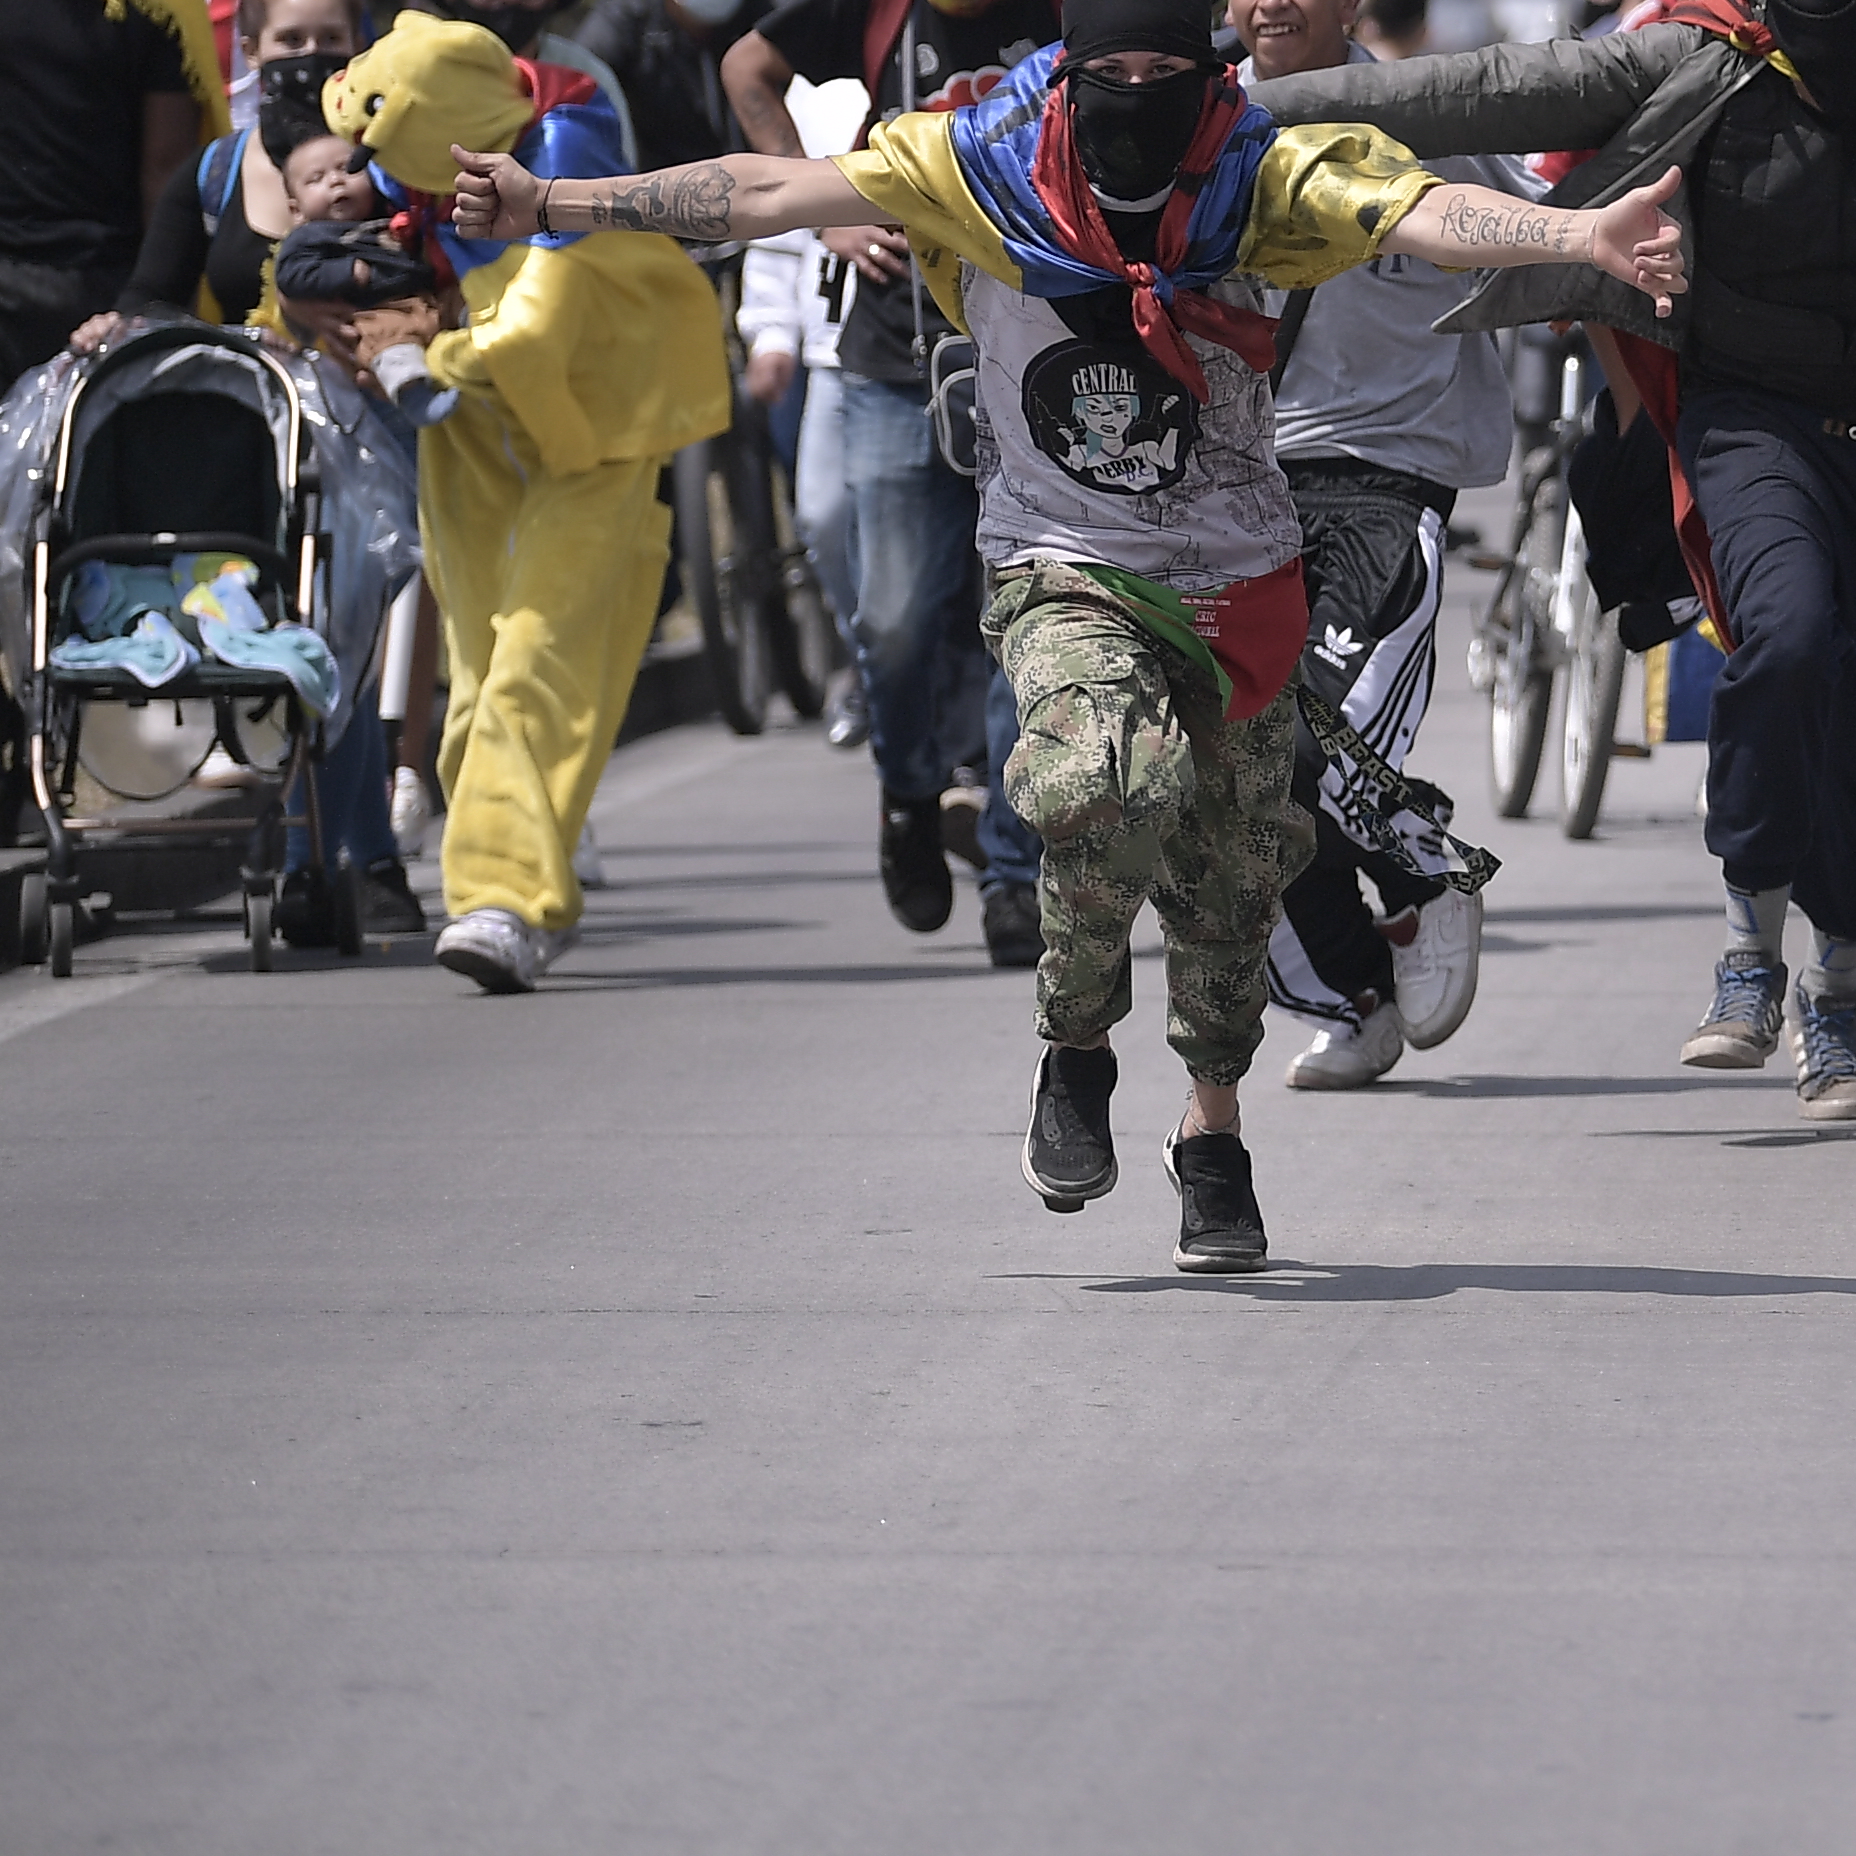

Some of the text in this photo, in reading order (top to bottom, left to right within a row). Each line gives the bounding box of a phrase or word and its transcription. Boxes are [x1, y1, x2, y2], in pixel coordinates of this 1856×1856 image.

[1072, 363, 1138, 395] CENTRAL
[1314, 645, 1347, 670] adidas
[1331, 726, 1412, 804] BEAST
